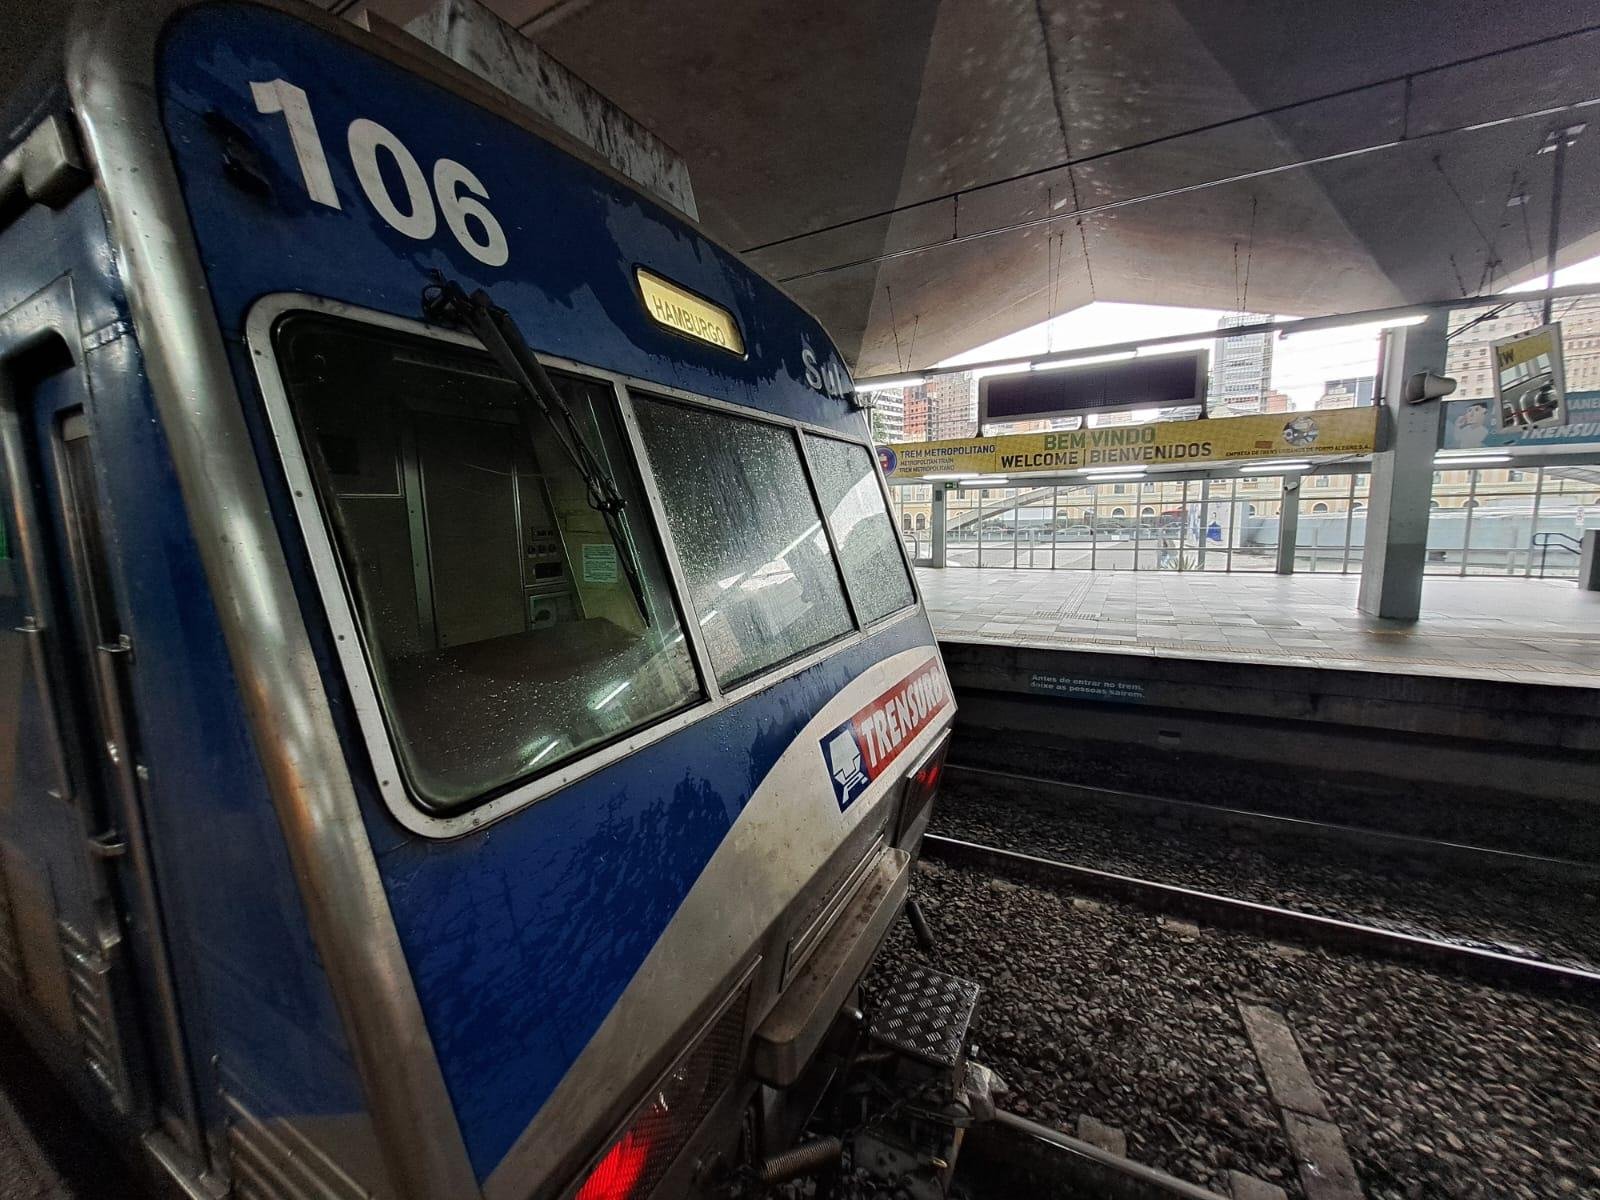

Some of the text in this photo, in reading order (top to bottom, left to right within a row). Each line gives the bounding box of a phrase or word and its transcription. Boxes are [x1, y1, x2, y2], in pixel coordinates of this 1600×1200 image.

[249, 78, 510, 267] 106
[652, 294, 726, 346] HAMBURGO
[900, 444, 996, 459] TREM METROPOLITANO
[1044, 427, 1156, 451] BEM VINDO
[1000, 442, 1212, 468] WELCOME BIENVENIDOS
[1031, 674, 1057, 683] Antes
[1059, 676, 1071, 684] de
[1069, 686, 1108, 695] pessoas
[861, 666, 944, 768] TRENSURB
